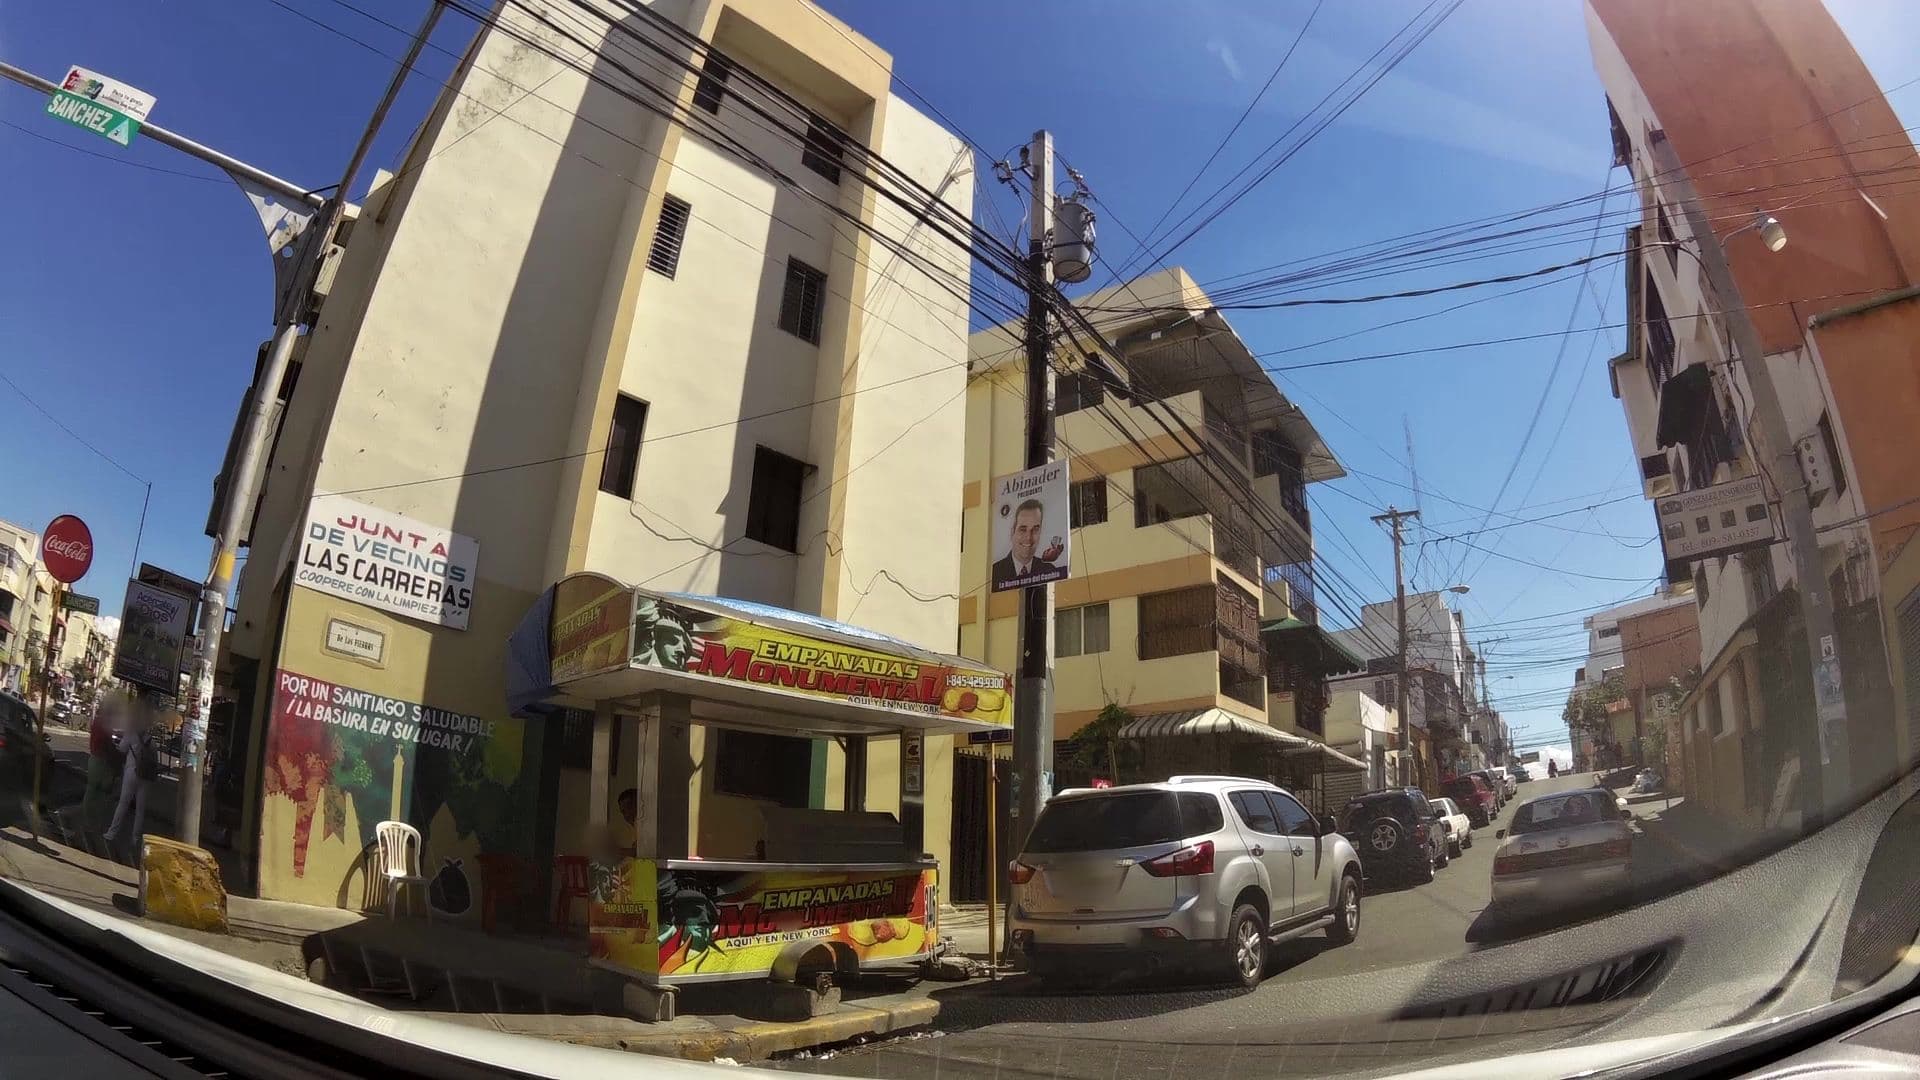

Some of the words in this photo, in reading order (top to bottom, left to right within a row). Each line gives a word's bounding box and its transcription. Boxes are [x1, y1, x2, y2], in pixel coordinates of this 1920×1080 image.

[48, 93, 114, 133] SANCHEZ
[1001, 468, 1061, 496] Abinader
[309, 521, 346, 547] DE
[353, 534, 467, 583] VECINOS
[336, 514, 449, 559] JUNTA
[299, 569, 354, 594] COOPERE
[355, 584, 375, 599] CON
[376, 591, 392, 604] LA
[303, 543, 350, 576] LAS
[353, 558, 472, 609] CARRERAS
[699, 642, 946, 706] MONUMENTAL
[757, 639, 920, 679] EMPANADAS
[281, 674, 309, 697] POR
[311, 682, 330, 702] UN
[411, 704, 496, 738] SALUDABLE
[313, 704, 368, 732] BASURA
[370, 717, 391, 736] EN
[391, 722, 413, 741] SU
[847, 695, 871, 705] AQUI
[882, 700, 894, 709] EN
[896, 701, 915, 711] NEW
[916, 703, 940, 714] YORK
[761, 879, 896, 911] EMPANADAS
[726, 938, 752, 948] AQUI
[755, 936, 761, 945] Y
[765, 935, 778, 944] EN
[781, 931, 803, 942] NEW
[806, 927, 832, 938] YORK
